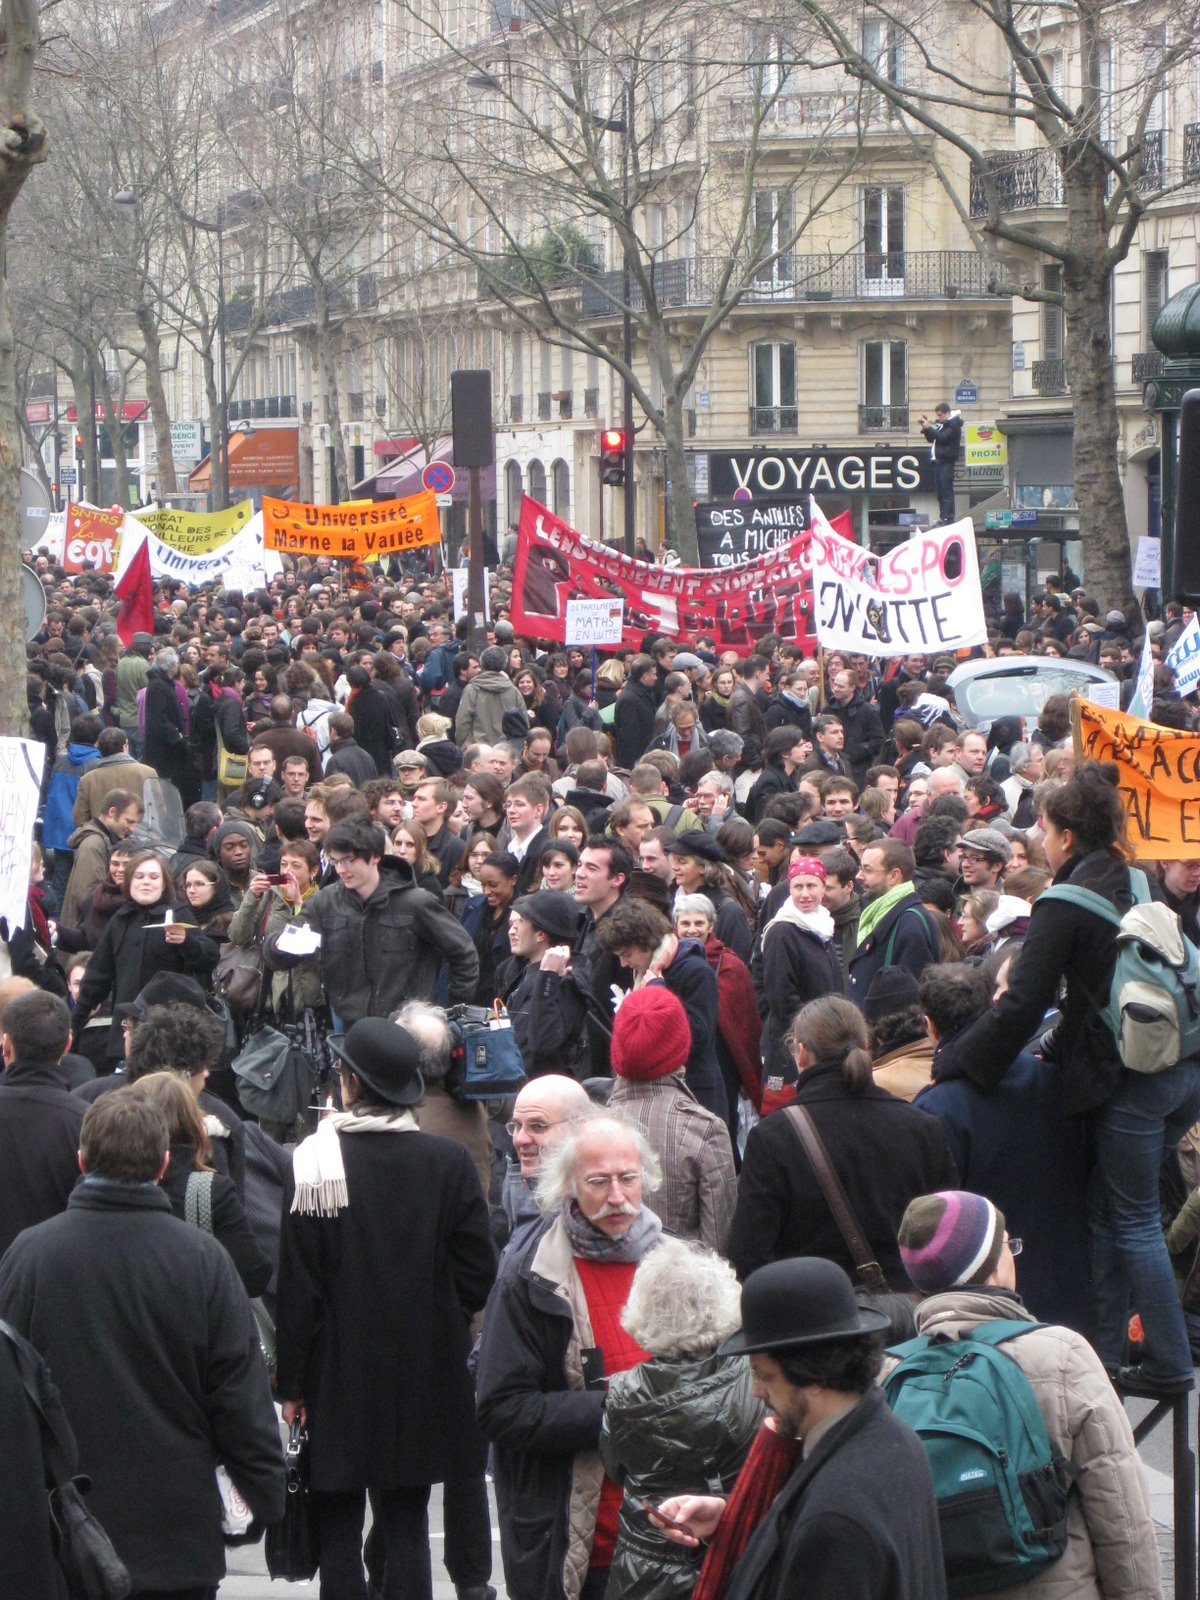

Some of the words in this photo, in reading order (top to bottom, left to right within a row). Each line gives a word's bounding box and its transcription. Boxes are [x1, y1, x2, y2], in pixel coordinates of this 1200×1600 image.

[730, 455, 921, 490] VOYAGES
[71, 505, 119, 525] SNTRS
[305, 503, 408, 526] Université
[710, 509, 745, 526] DES
[751, 505, 805, 527] ANTILLES
[186, 526, 212, 534] DES
[273, 528, 331, 551] Marne
[364, 527, 425, 551] Vallée
[719, 531, 734, 549] A
[711, 552, 750, 567] TOUS
[575, 616, 615, 629] MATHS
[575, 629, 591, 641] EN
[593, 628, 619, 640] LUTTE
